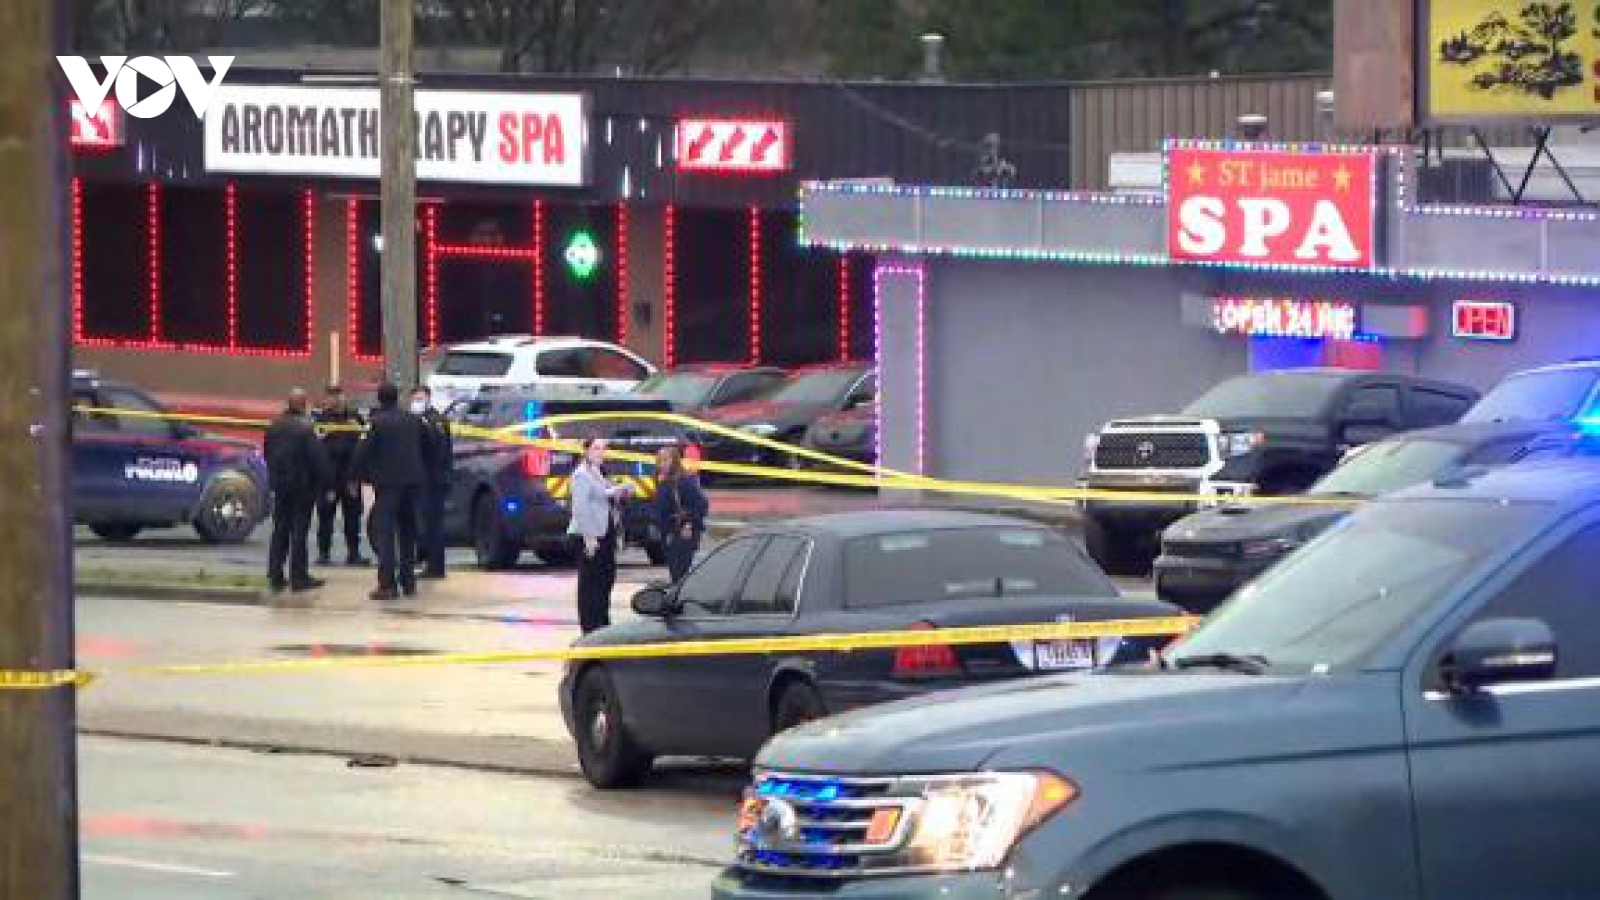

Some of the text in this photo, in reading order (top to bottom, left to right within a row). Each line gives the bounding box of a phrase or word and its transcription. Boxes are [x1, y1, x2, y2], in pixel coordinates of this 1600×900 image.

[221, 102, 565, 165] AROMATHAPY SPA
[1219, 159, 1254, 187] ST
[1177, 195, 1362, 262] SPA
[1457, 304, 1509, 334] OPEN
